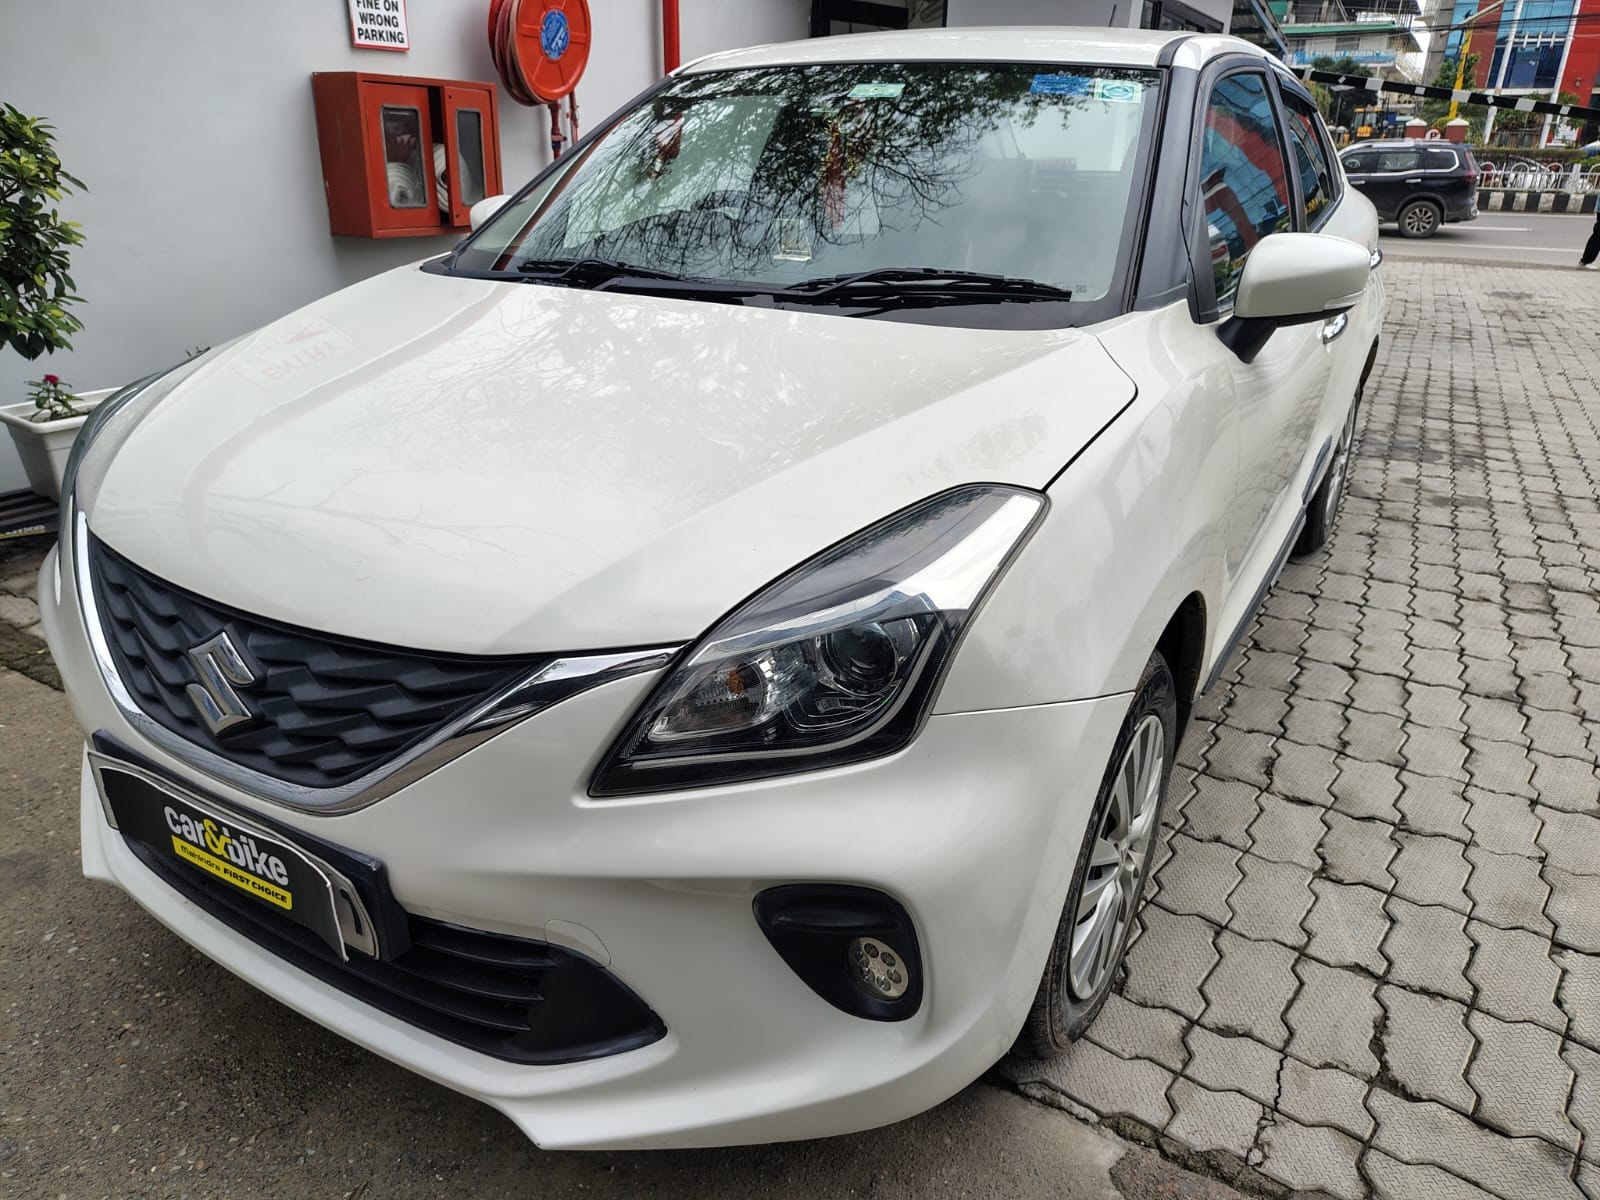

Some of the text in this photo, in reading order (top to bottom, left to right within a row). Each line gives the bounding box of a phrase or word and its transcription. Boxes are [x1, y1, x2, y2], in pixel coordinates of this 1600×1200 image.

[356, 0, 399, 12] FINE ON
[358, 11, 399, 28] WRONG
[357, 27, 405, 43] PARKING
[164, 806, 289, 886] car&bike
[223, 867, 250, 885] FIRST
[251, 880, 288, 904] CHOICE
